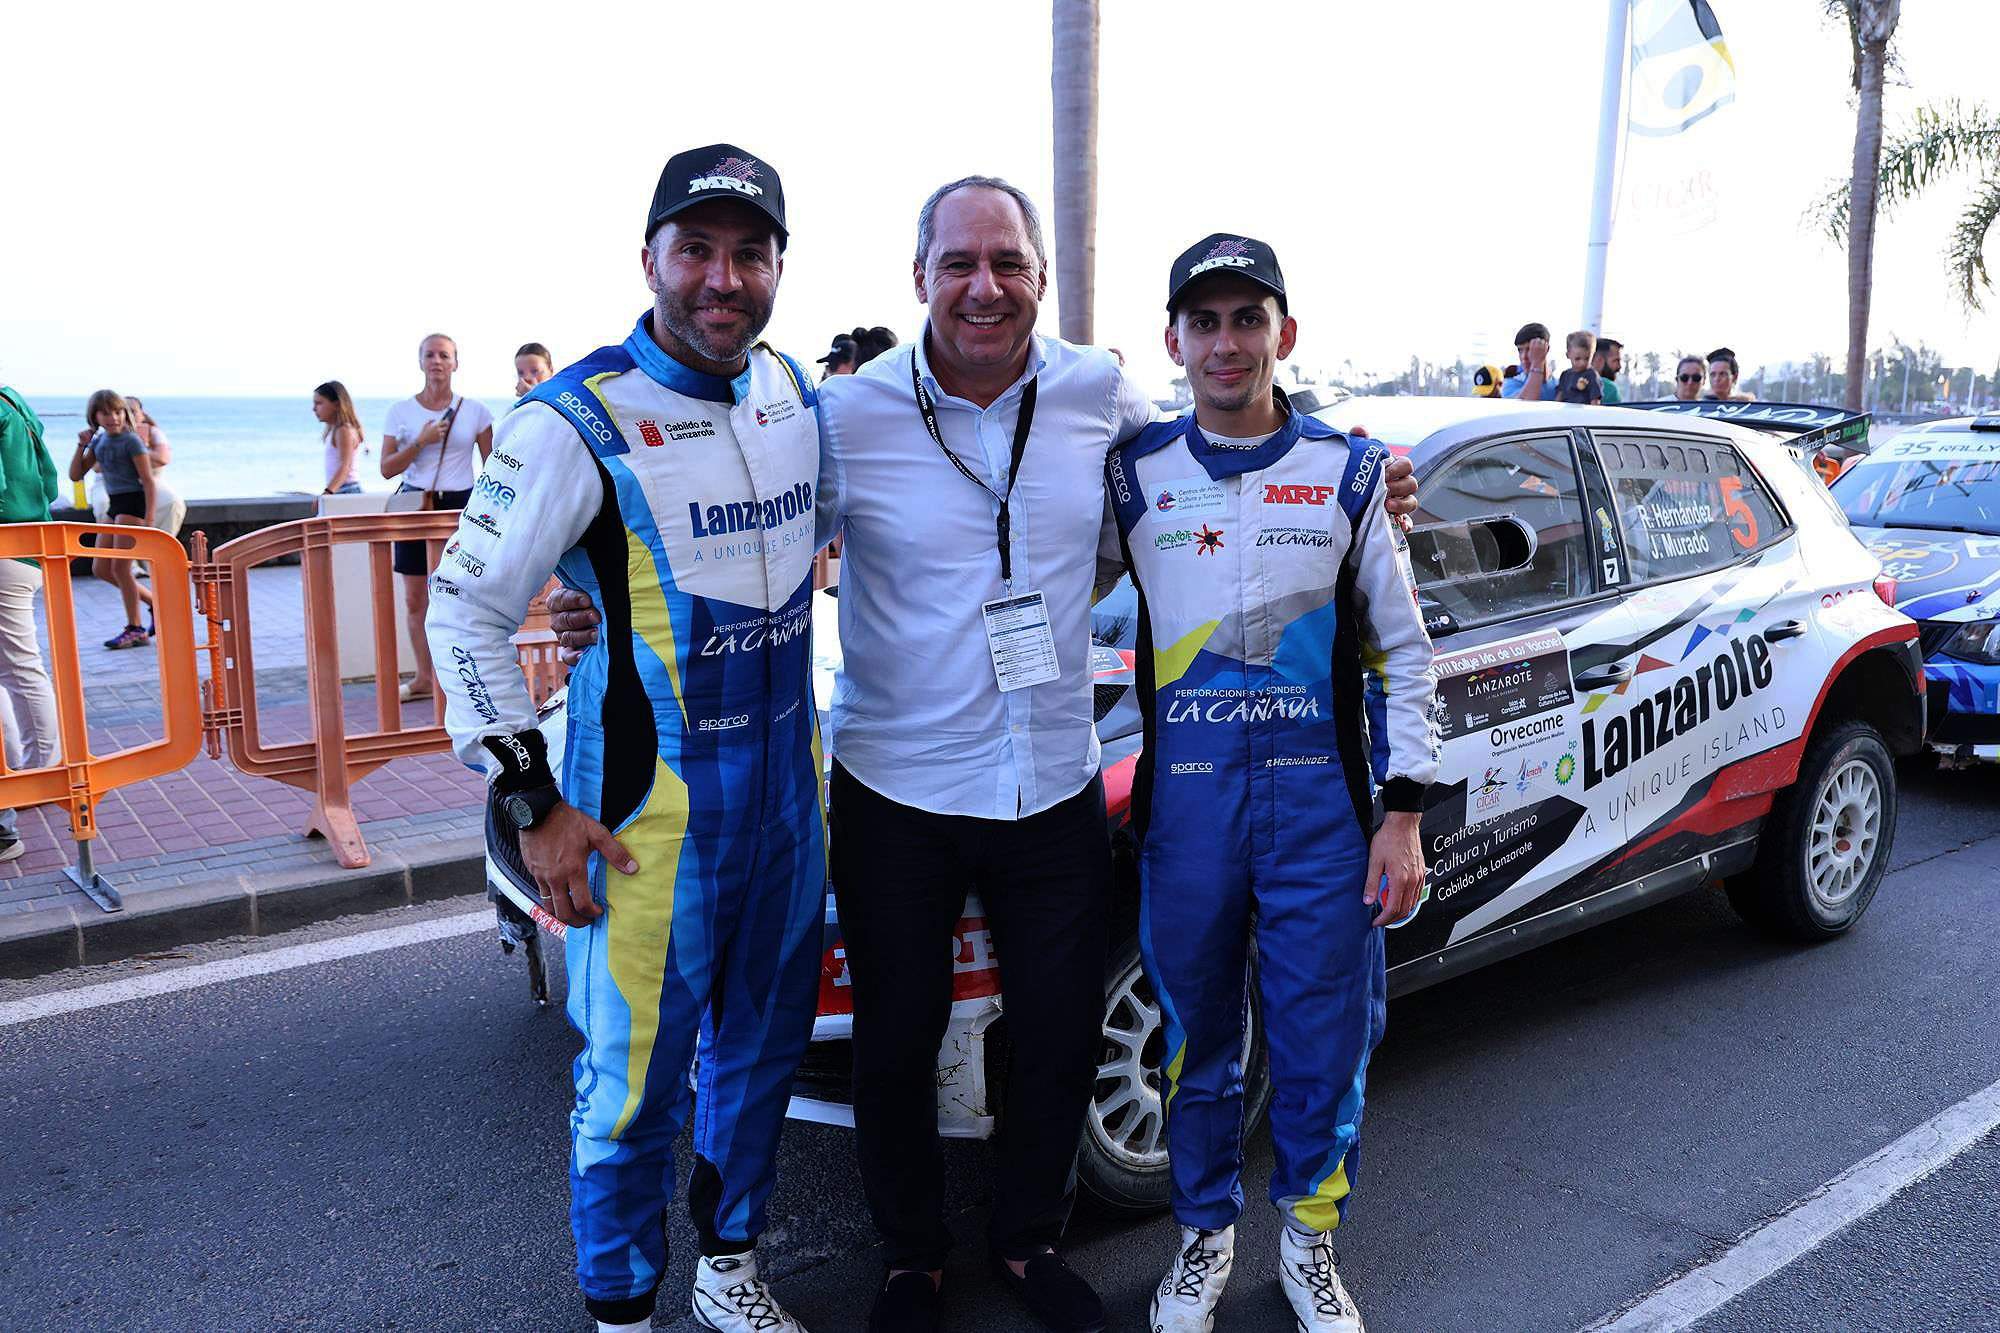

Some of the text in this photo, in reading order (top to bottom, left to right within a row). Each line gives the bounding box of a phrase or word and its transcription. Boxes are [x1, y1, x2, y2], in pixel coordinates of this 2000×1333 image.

[688, 175, 763, 197] MRF
[1188, 255, 1255, 279] MRF
[556, 391, 613, 445] sparco
[664, 419, 713, 433] Cabildo de
[669, 429, 716, 441] Lanzarote
[1108, 449, 1132, 504] sparco
[1351, 445, 1383, 496] sparco
[1203, 493, 1225, 501] Turismo
[1263, 485, 1334, 505] MRF
[688, 481, 812, 539] Lanzarote
[1638, 500, 1714, 529] R. Hernández
[1719, 475, 1759, 549] 5
[465, 514, 502, 538] motorsport
[1256, 532, 1333, 547] LA CAÑADA
[694, 550, 704, 562] A
[714, 541, 777, 561] UNIQUE
[1650, 530, 1710, 560] J. Murado
[1606, 563, 1616, 579] 7
[700, 608, 812, 656] LA CAÑADA
[1453, 658, 1480, 672] Rallye
[1499, 649, 1510, 659] de
[452, 645, 498, 725] LA CAÑADA
[1175, 685, 1307, 698] PERFORACIONES Y SONDEOS
[1467, 670, 1533, 697] LANZAROTE
[698, 714, 750, 731] sparco
[1166, 696, 1319, 723] LA CAÑADA
[1581, 634, 1773, 792] Lanzarote
[1490, 714, 1564, 747] Orvecame
[1567, 740, 1578, 750] bp
[1170, 762, 1214, 774] sparco
[1585, 814, 1596, 838] A
[1608, 754, 1690, 821] UNIQUE
[1704, 706, 1786, 765] ISLAND
[1433, 822, 1481, 853] Centros
[1433, 814, 1538, 877] Cultura y Turismo
[1437, 840, 1533, 901] Cabildo de Lanzarote
